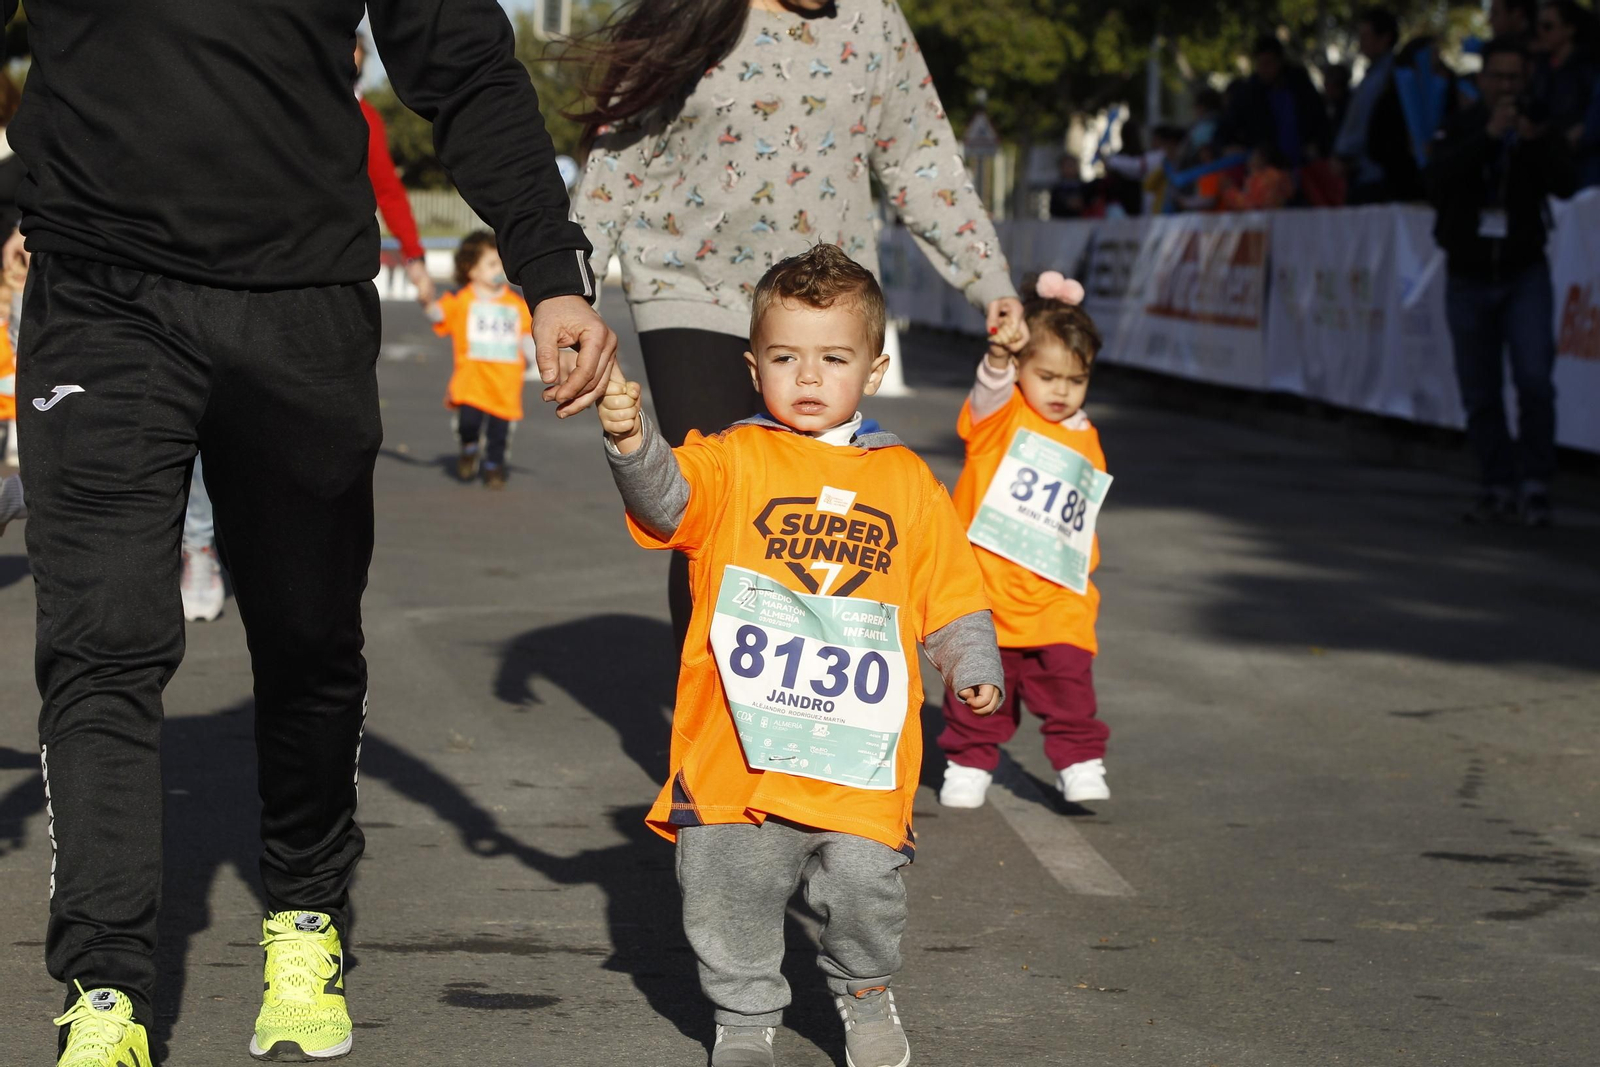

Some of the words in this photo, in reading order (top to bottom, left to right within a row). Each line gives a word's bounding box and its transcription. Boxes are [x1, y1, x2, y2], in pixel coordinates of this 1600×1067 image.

[1010, 467, 1087, 532] 8188
[1017, 505, 1042, 521] MINI
[779, 513, 884, 548] SUPER
[764, 537, 892, 575] RUNNER
[759, 608, 800, 625] ALMERÍA
[762, 599, 806, 617] MARATÓN
[843, 626, 889, 642] INFANTIL
[729, 624, 890, 705] 8130
[751, 701, 786, 715] ALEJANDRO
[766, 689, 835, 713] JANDRO
